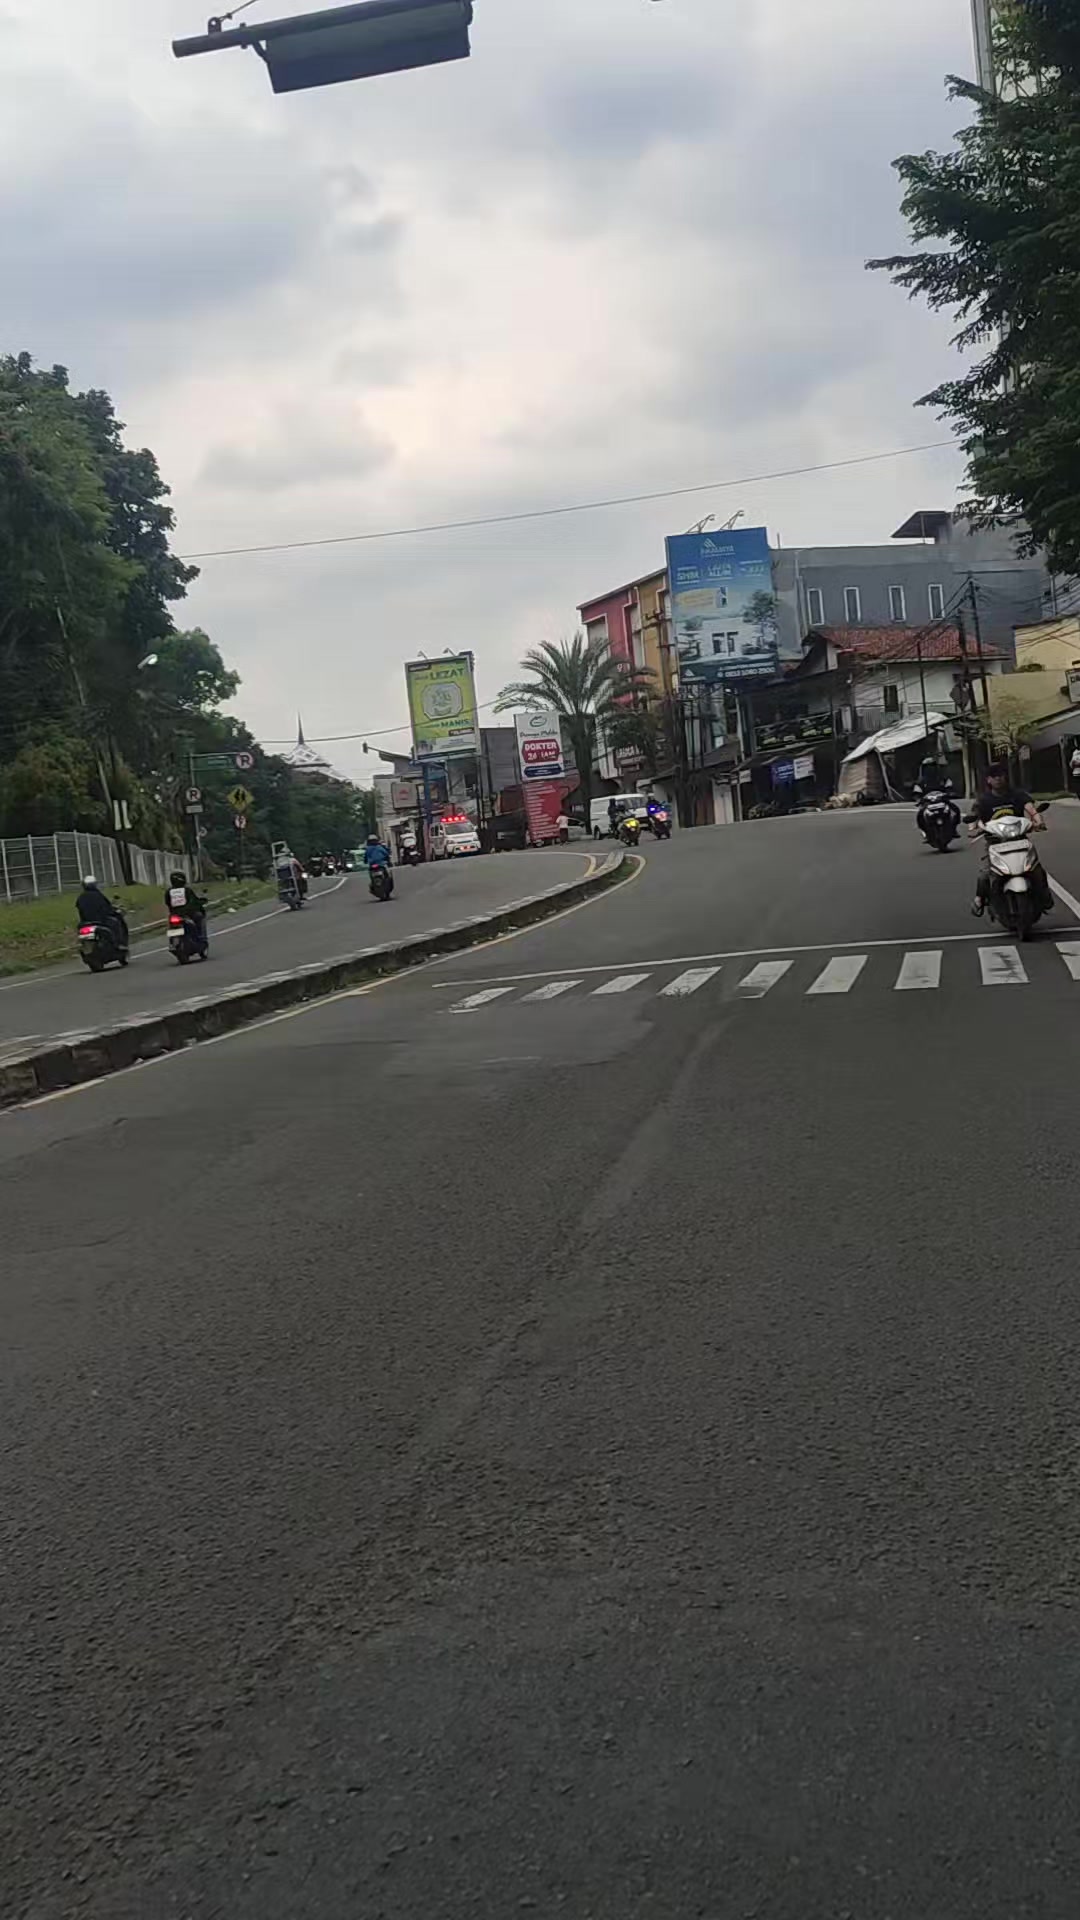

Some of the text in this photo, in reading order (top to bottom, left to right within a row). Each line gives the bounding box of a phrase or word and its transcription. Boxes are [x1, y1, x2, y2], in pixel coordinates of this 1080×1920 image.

[430, 667, 464, 680] LEZAT
[440, 719, 470, 728] MANIS
[525, 741, 557, 751] DOKTER
